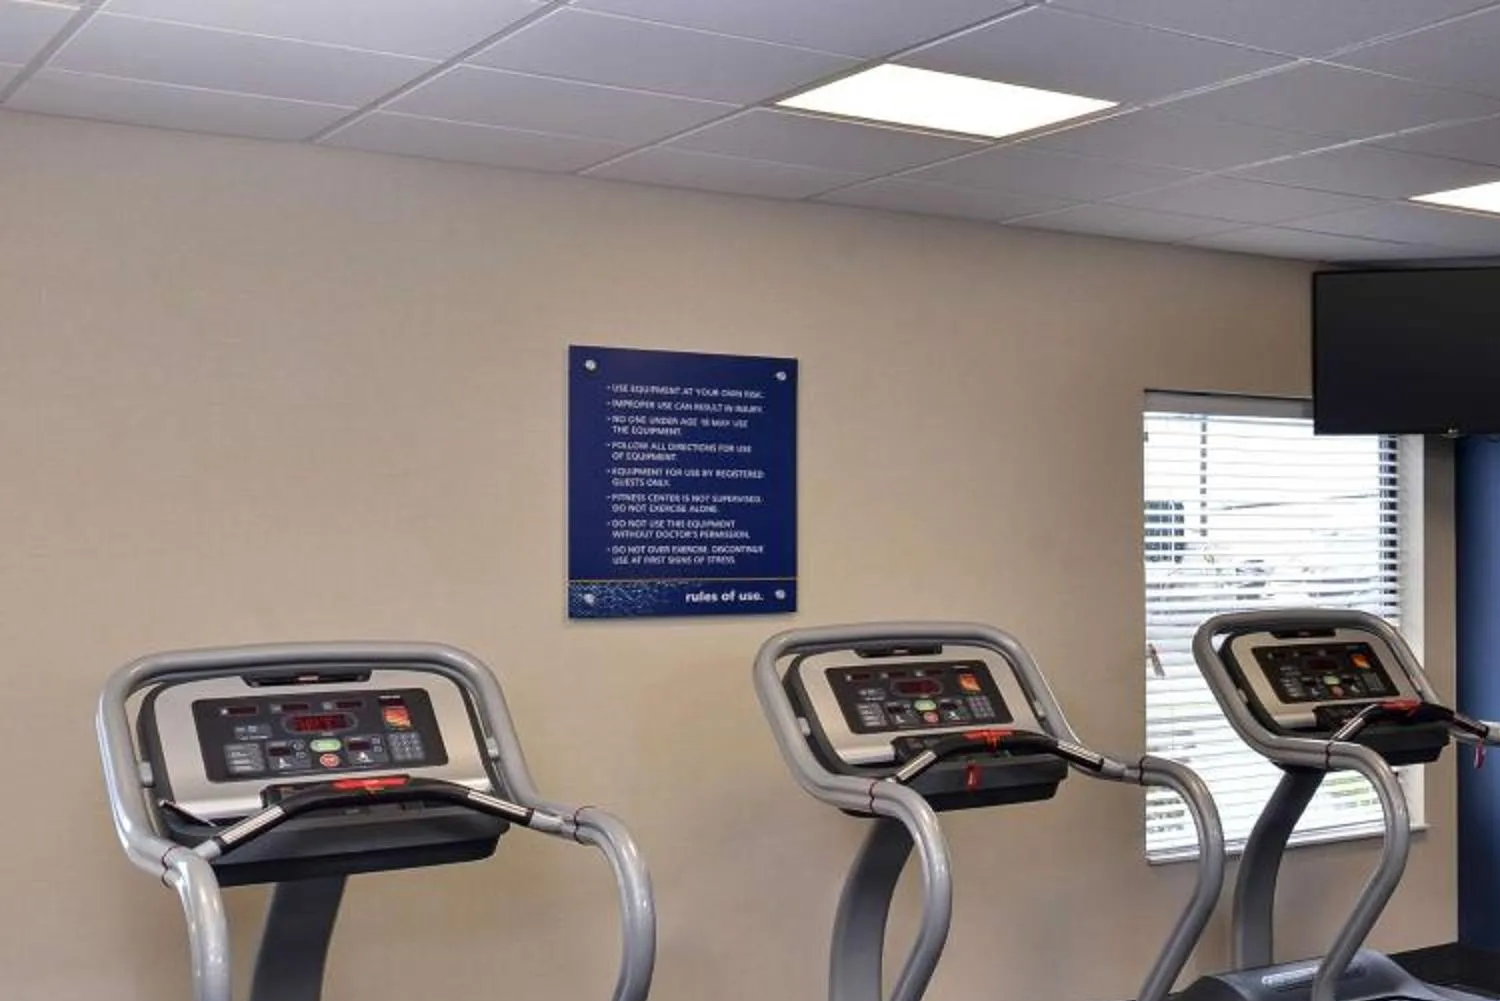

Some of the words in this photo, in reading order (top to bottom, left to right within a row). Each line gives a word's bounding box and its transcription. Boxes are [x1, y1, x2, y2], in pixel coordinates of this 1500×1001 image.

[612, 384, 628, 394] USE
[630, 385, 681, 396] EQUIPMENT
[682, 387, 693, 396] AT
[695, 387, 718, 397] YOUR
[612, 399, 655, 409] IMPROPER
[657, 401, 672, 410] USE
[674, 401, 692, 411] CAN
[612, 415, 627, 424] NO
[628, 415, 647, 425] ONE
[649, 416, 678, 426] UNDER
[680, 417, 697, 427] AGE
[731, 419, 748, 428] USE
[613, 426, 629, 434] THE
[612, 442, 649, 451] FOLLOW
[651, 443, 666, 451] ALL
[718, 444, 734, 452] FOR
[612, 452, 624, 460] OF
[612, 468, 663, 477] EQUIPMENT
[665, 469, 682, 477] FOR
[684, 469, 700, 477] USE
[702, 470, 713, 478] BY
[612, 478, 645, 486] GUESTS
[648, 494, 680, 502] CENTER
[612, 504, 627, 512] DO
[628, 504, 646, 512] NOT
[649, 504, 686, 512] EXERCISE
[612, 520, 627, 528] DO
[628, 520, 647, 528] NOT
[650, 520, 666, 528] USE
[668, 520, 686, 528] THIS
[687, 520, 736, 528] EQUIPMENT
[612, 530, 654, 538] WITHOUT
[612, 546, 627, 554] DO
[628, 546, 646, 554] NOT
[647, 546, 670, 554] OVER
[612, 556, 628, 564] USE
[631, 556, 642, 564] AT
[685, 591, 717, 603] rules
[721, 588, 735, 602] of
[738, 591, 764, 601] use.
